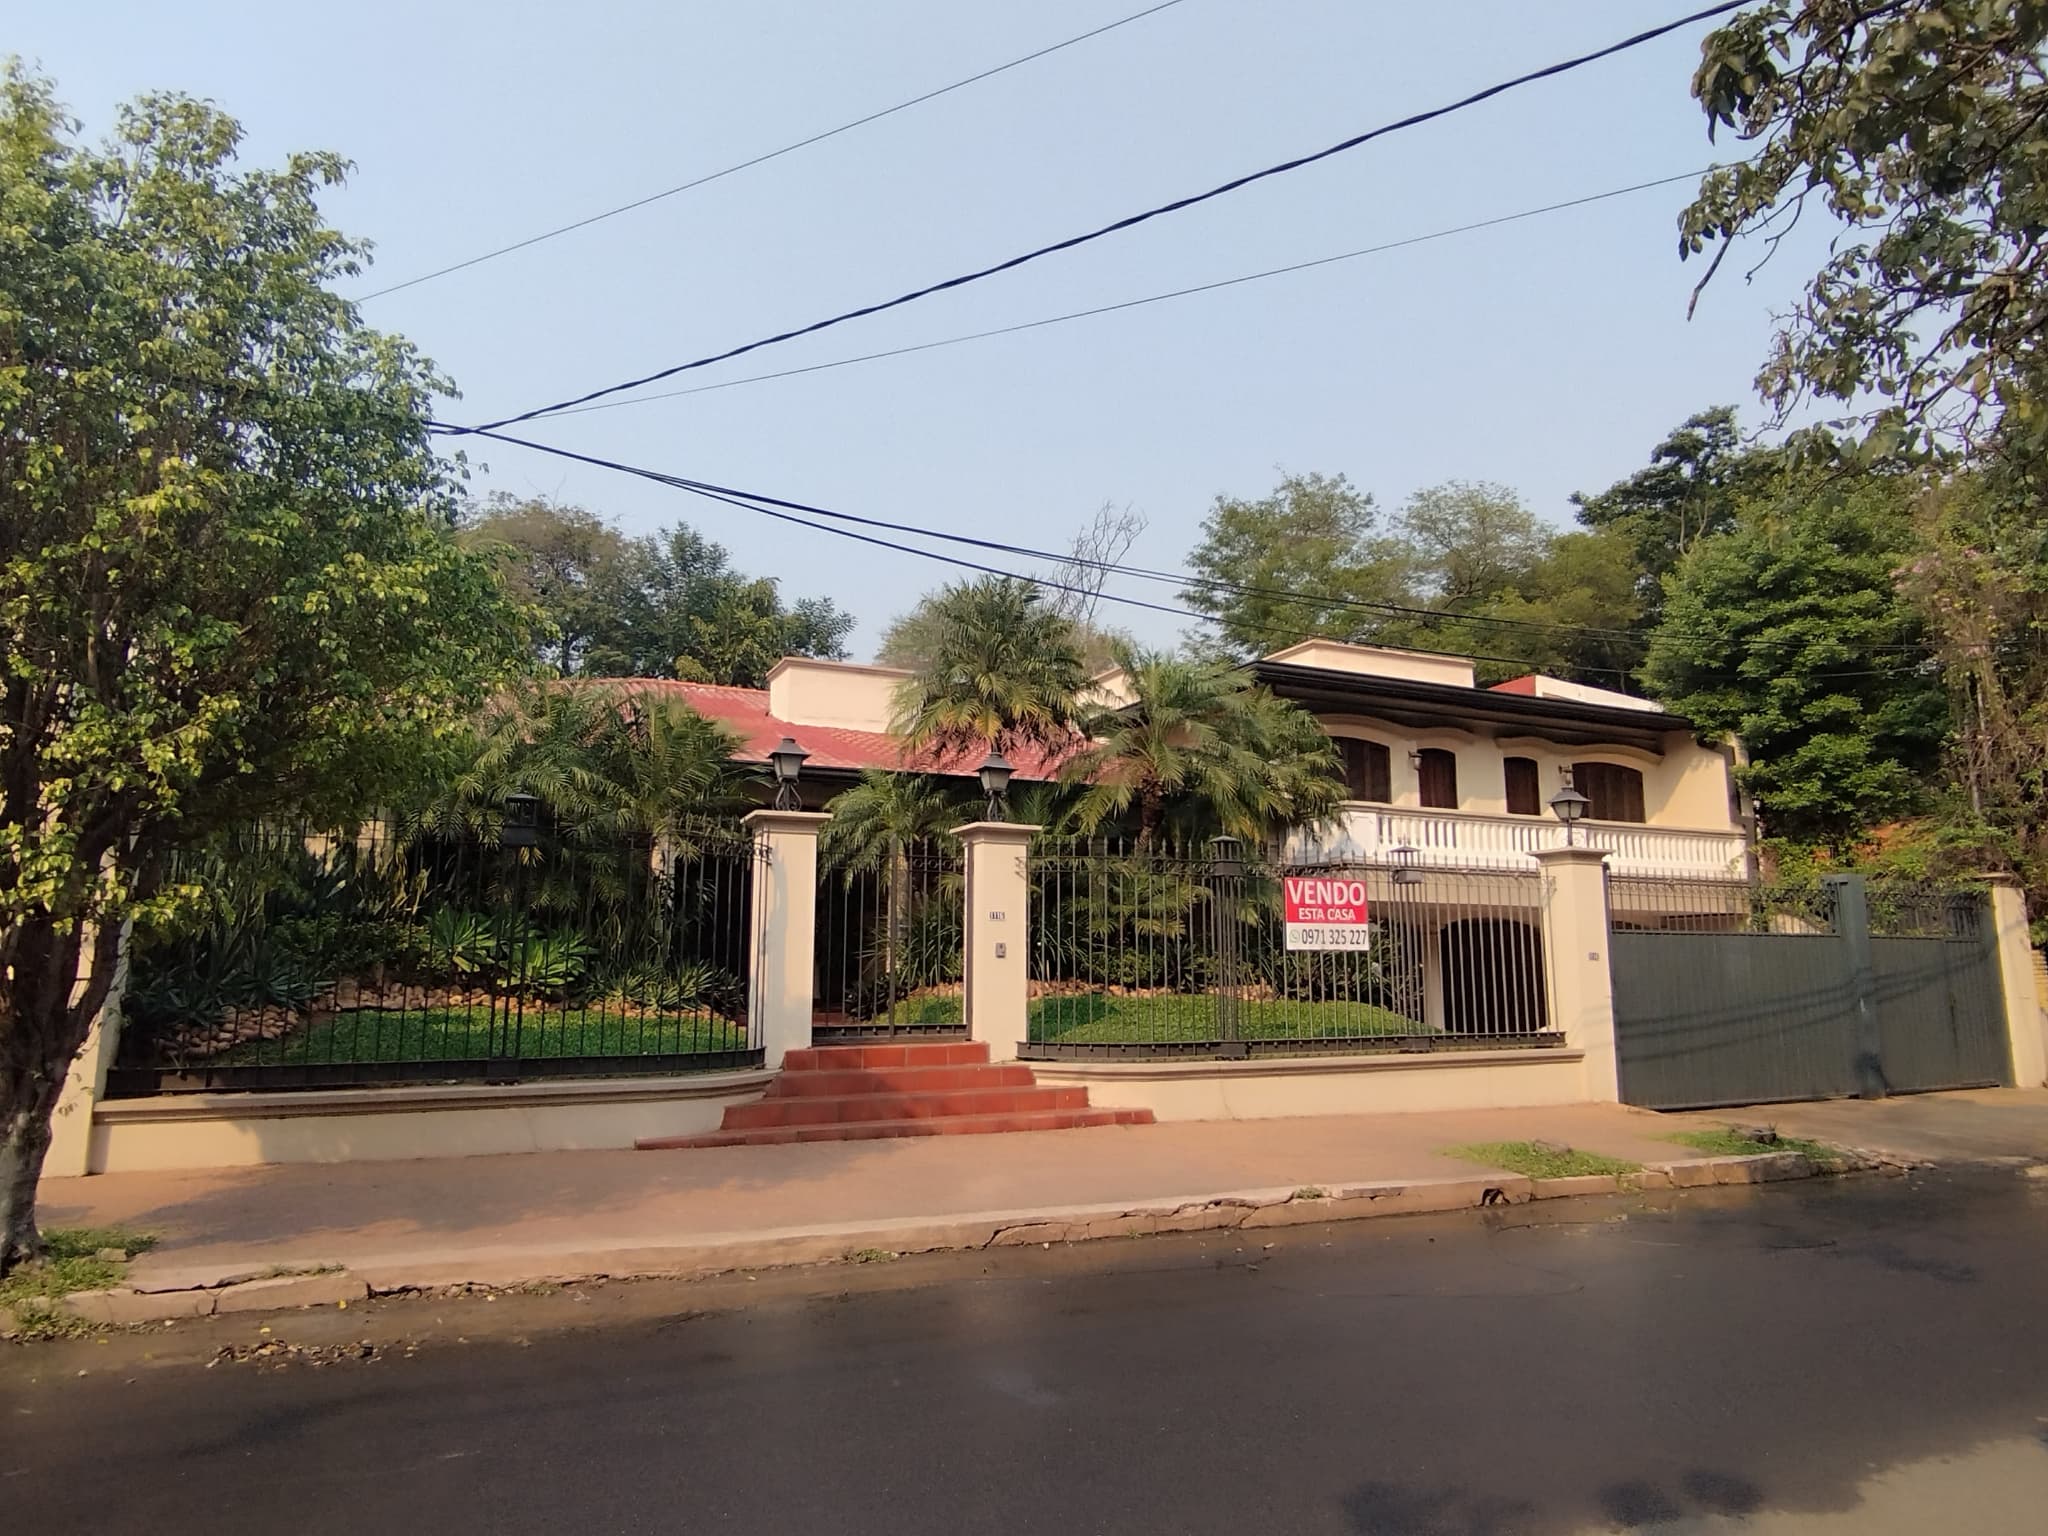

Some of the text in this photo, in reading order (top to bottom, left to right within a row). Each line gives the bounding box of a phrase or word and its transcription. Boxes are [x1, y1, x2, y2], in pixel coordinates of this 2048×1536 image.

[1287, 880, 1365, 906] VENDO
[1299, 908, 1356, 921] ESTA CASA
[1302, 929, 1367, 945] 0971 325 227
